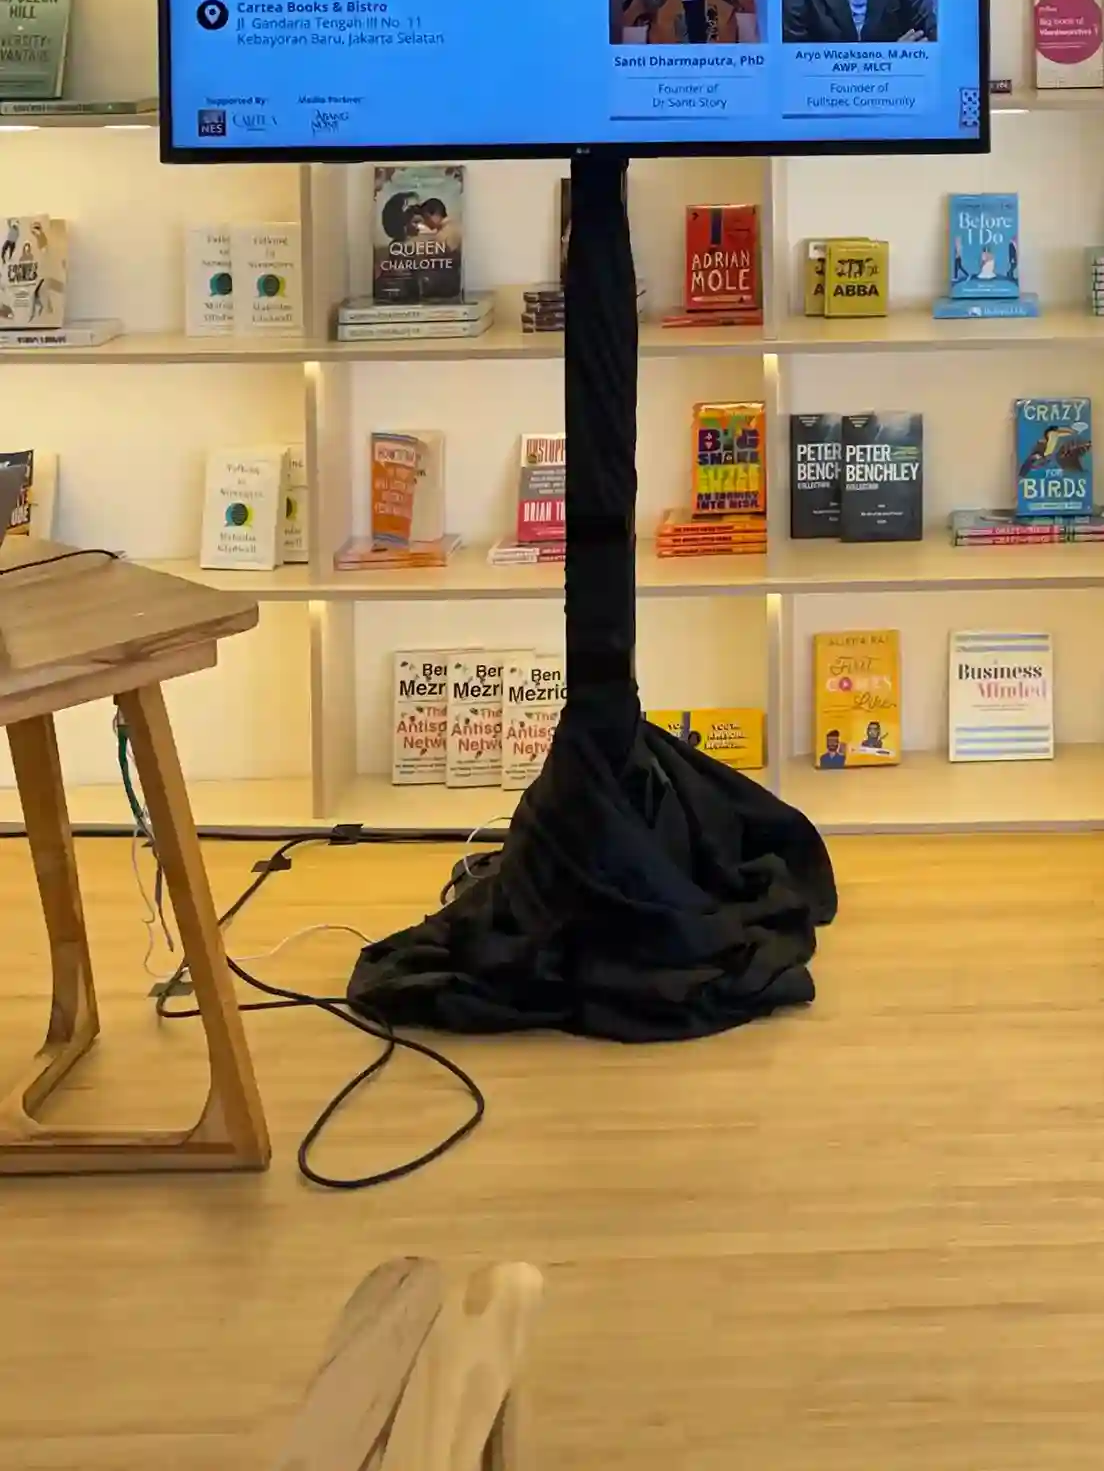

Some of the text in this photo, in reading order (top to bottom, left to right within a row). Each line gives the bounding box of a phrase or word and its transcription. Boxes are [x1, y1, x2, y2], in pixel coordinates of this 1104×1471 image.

[9, 5, 36, 19] HILL
[237, 0, 388, 13] Cartea Books & Bistro
[252, 18, 310, 29] Gandaria
[315, 18, 362, 31] Tengah
[237, 33, 444, 48] Kebayoran Baru, Jakarta Selatan
[615, 55, 765, 68] Santi Dharmaputra, PhD
[795, 50, 821, 62] Aryo
[659, 83, 719, 94] Founder of
[830, 83, 889, 93] Founder of
[669, 97, 695, 107] Santi
[699, 97, 727, 109] Story
[807, 96, 916, 108] Fullspec Community
[959, 212, 1012, 229] Before
[980, 229, 1003, 245] Do
[389, 241, 446, 257] QUEEN
[380, 259, 453, 271] CHARLOTTE
[691, 250, 750, 270] ADRIAN
[691, 269, 750, 292] MOLE
[813, 284, 825, 296] A
[833, 284, 880, 297] ABBA
[1024, 401, 1087, 421] CRAZY
[797, 443, 841, 461] PETER
[846, 444, 892, 462] PETER
[846, 463, 920, 482] BENCHLEY
[1019, 478, 1086, 498] BIRDS
[524, 502, 552, 522] BRIAN
[531, 669, 560, 682] Ben
[958, 664, 1043, 680] Business
[399, 680, 446, 696] Mezr
[509, 685, 567, 702] Mezric
[977, 680, 1047, 700] Minded
